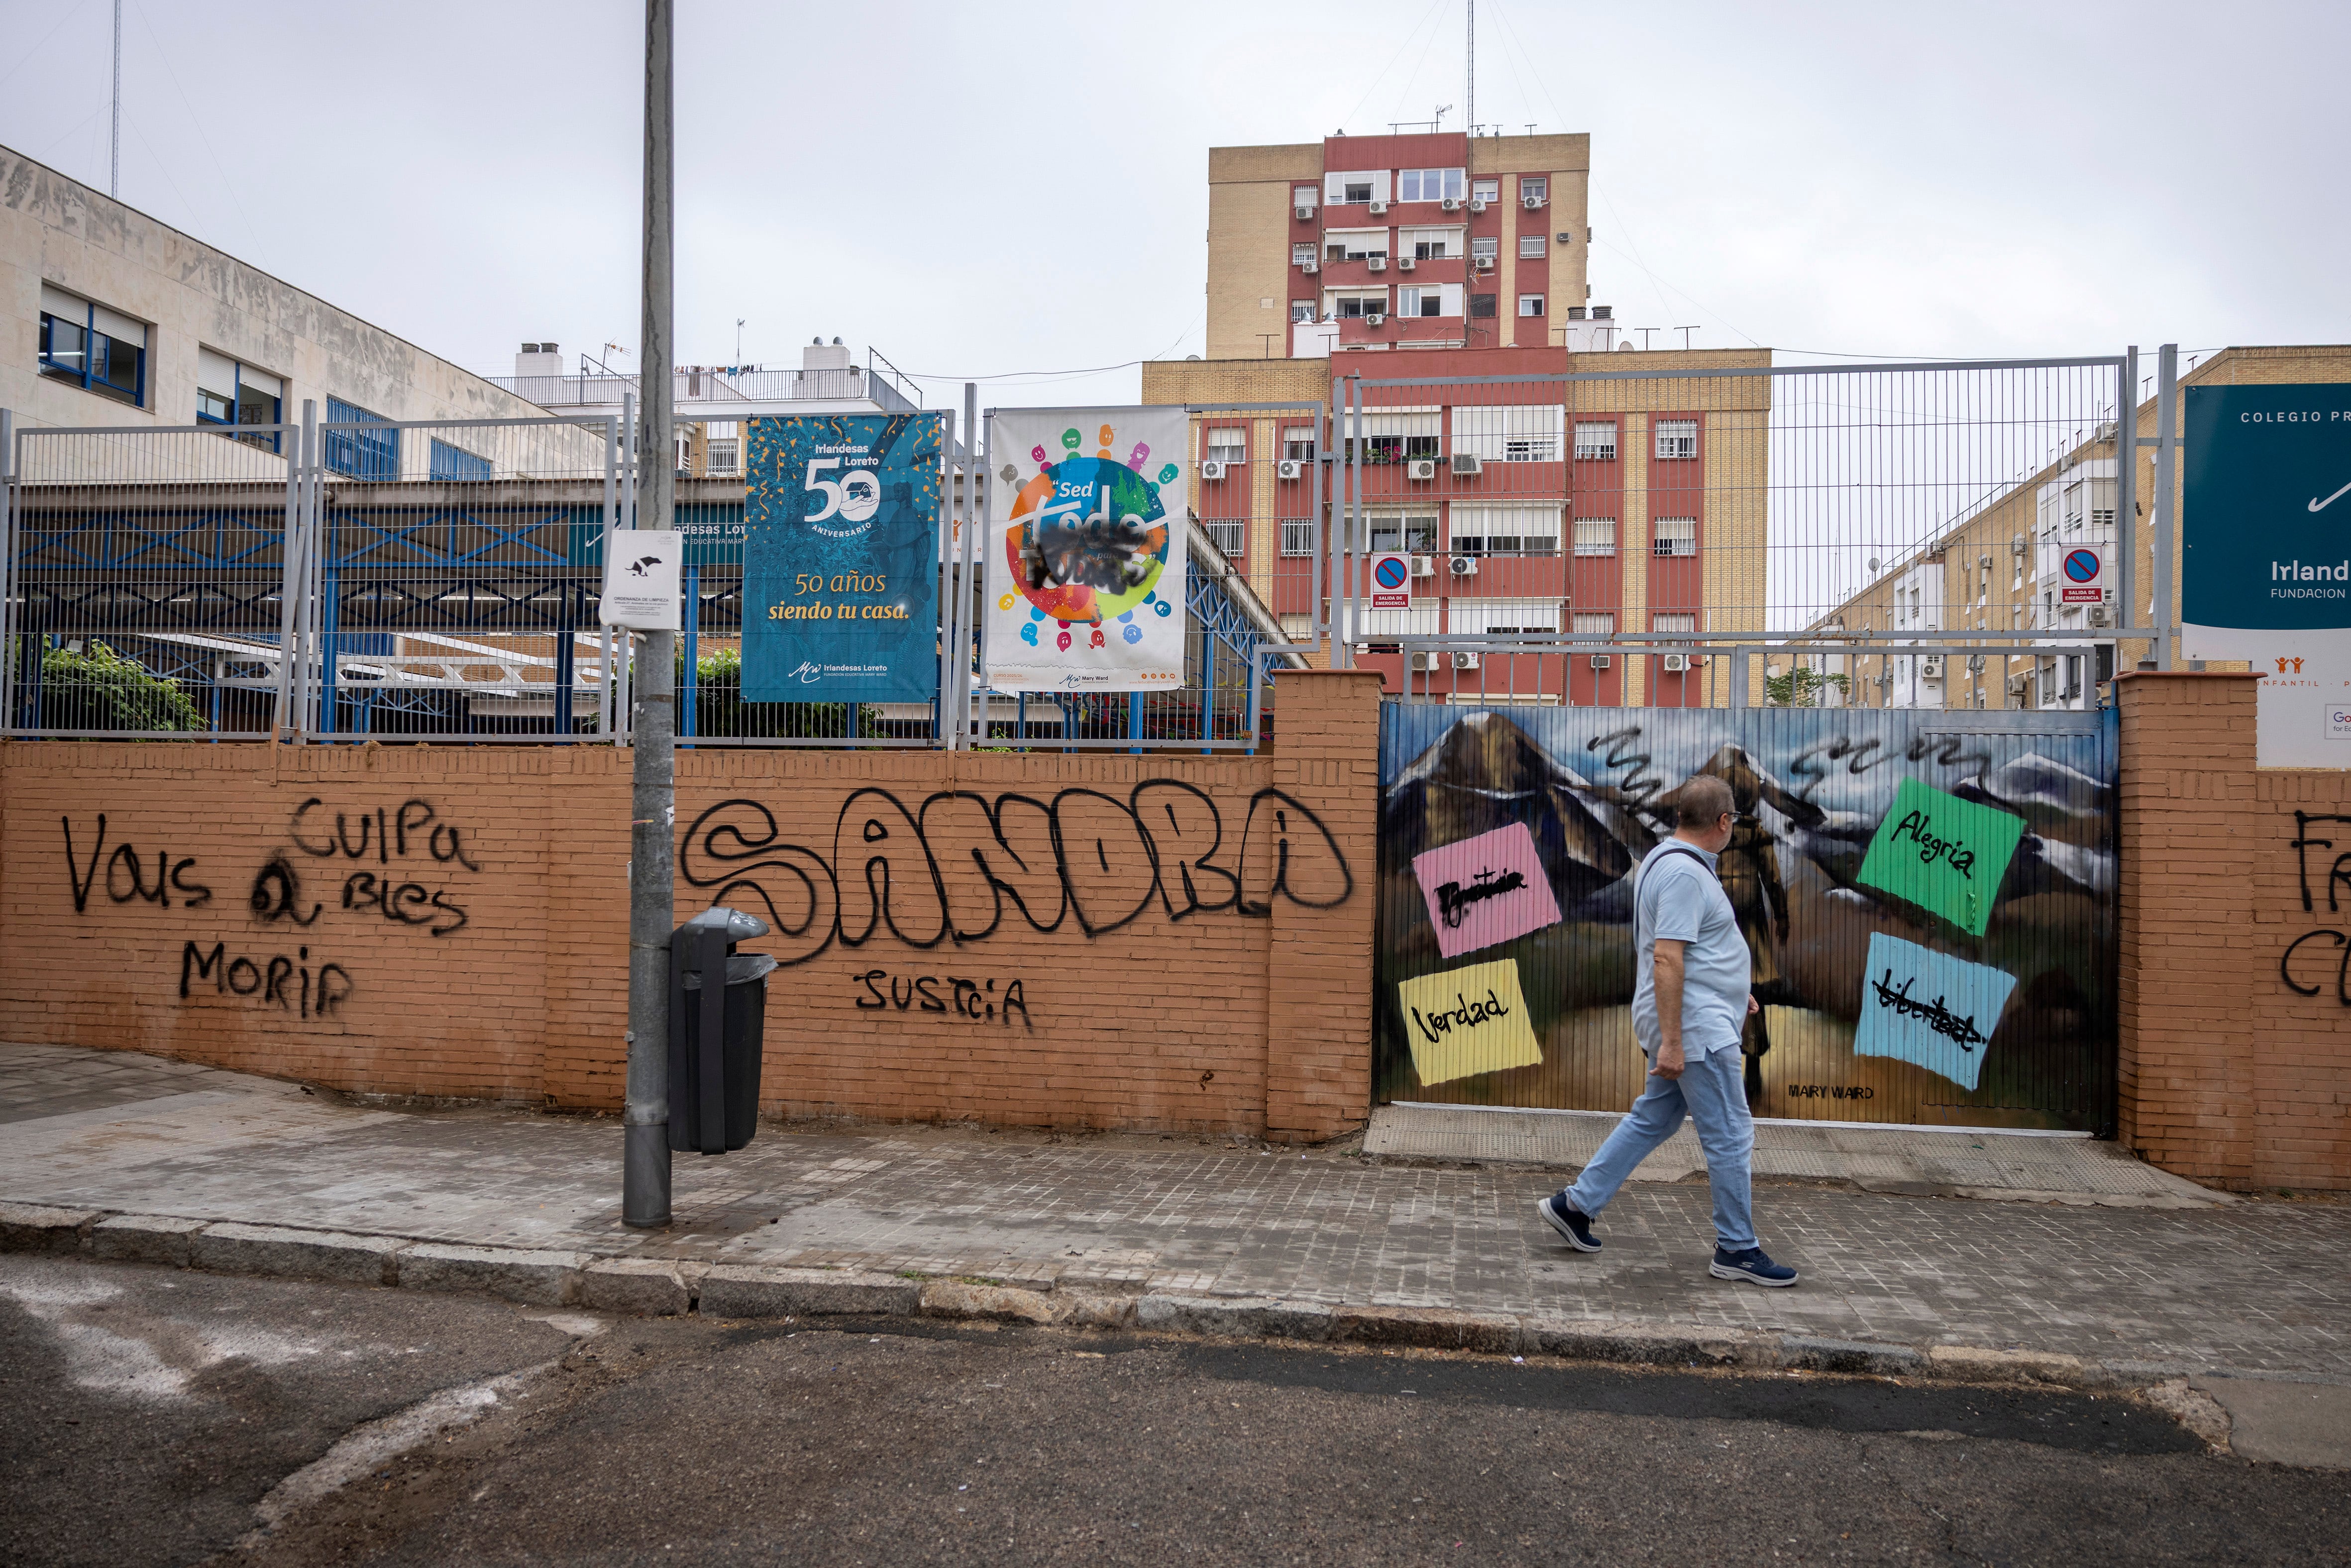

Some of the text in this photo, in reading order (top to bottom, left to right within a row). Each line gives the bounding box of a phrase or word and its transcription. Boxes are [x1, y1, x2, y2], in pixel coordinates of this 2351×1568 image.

[2241, 411, 2321, 423] COLEGIO
[815, 443, 869, 454] Irlandesas
[845, 457, 879, 466] Loreto
[804, 457, 880, 522] 50
[674, 523, 745, 534] ndesas Lor
[812, 522, 871, 537] ANIVERSARIO
[2272, 560, 2349, 581] Irland
[794, 570, 886, 595] 50 años
[2271, 588, 2346, 598] FUNDACION
[768, 601, 909, 620] siendo tu casa.
[680, 778, 1354, 966] SANDRA
[1411, 989, 1509, 1044] Verdad
[1788, 1084, 1874, 1099] MARY WARD
